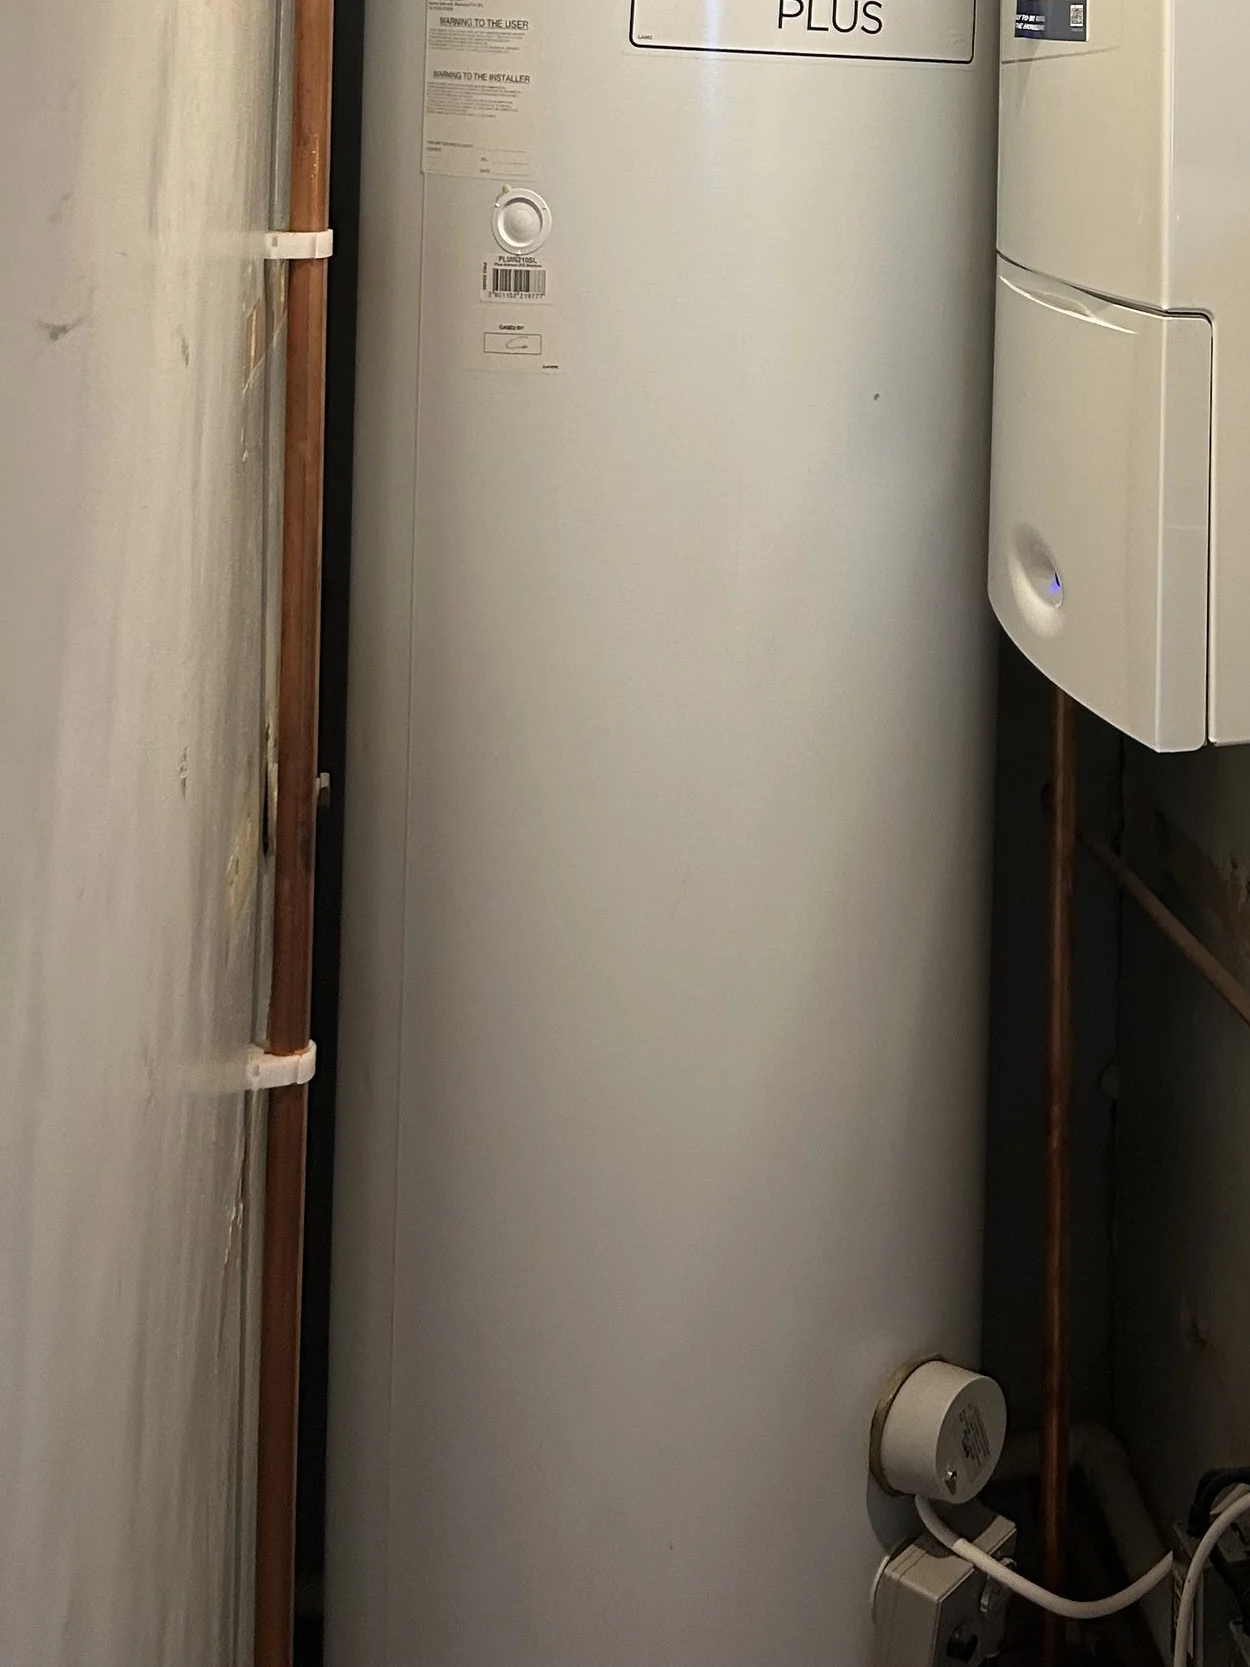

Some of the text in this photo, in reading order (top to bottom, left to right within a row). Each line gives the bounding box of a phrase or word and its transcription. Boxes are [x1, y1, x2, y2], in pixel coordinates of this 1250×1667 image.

[440, 17, 529, 30] WARNING TO THE USER
[433, 70, 531, 84] WARNING TO THE INSTALLER
